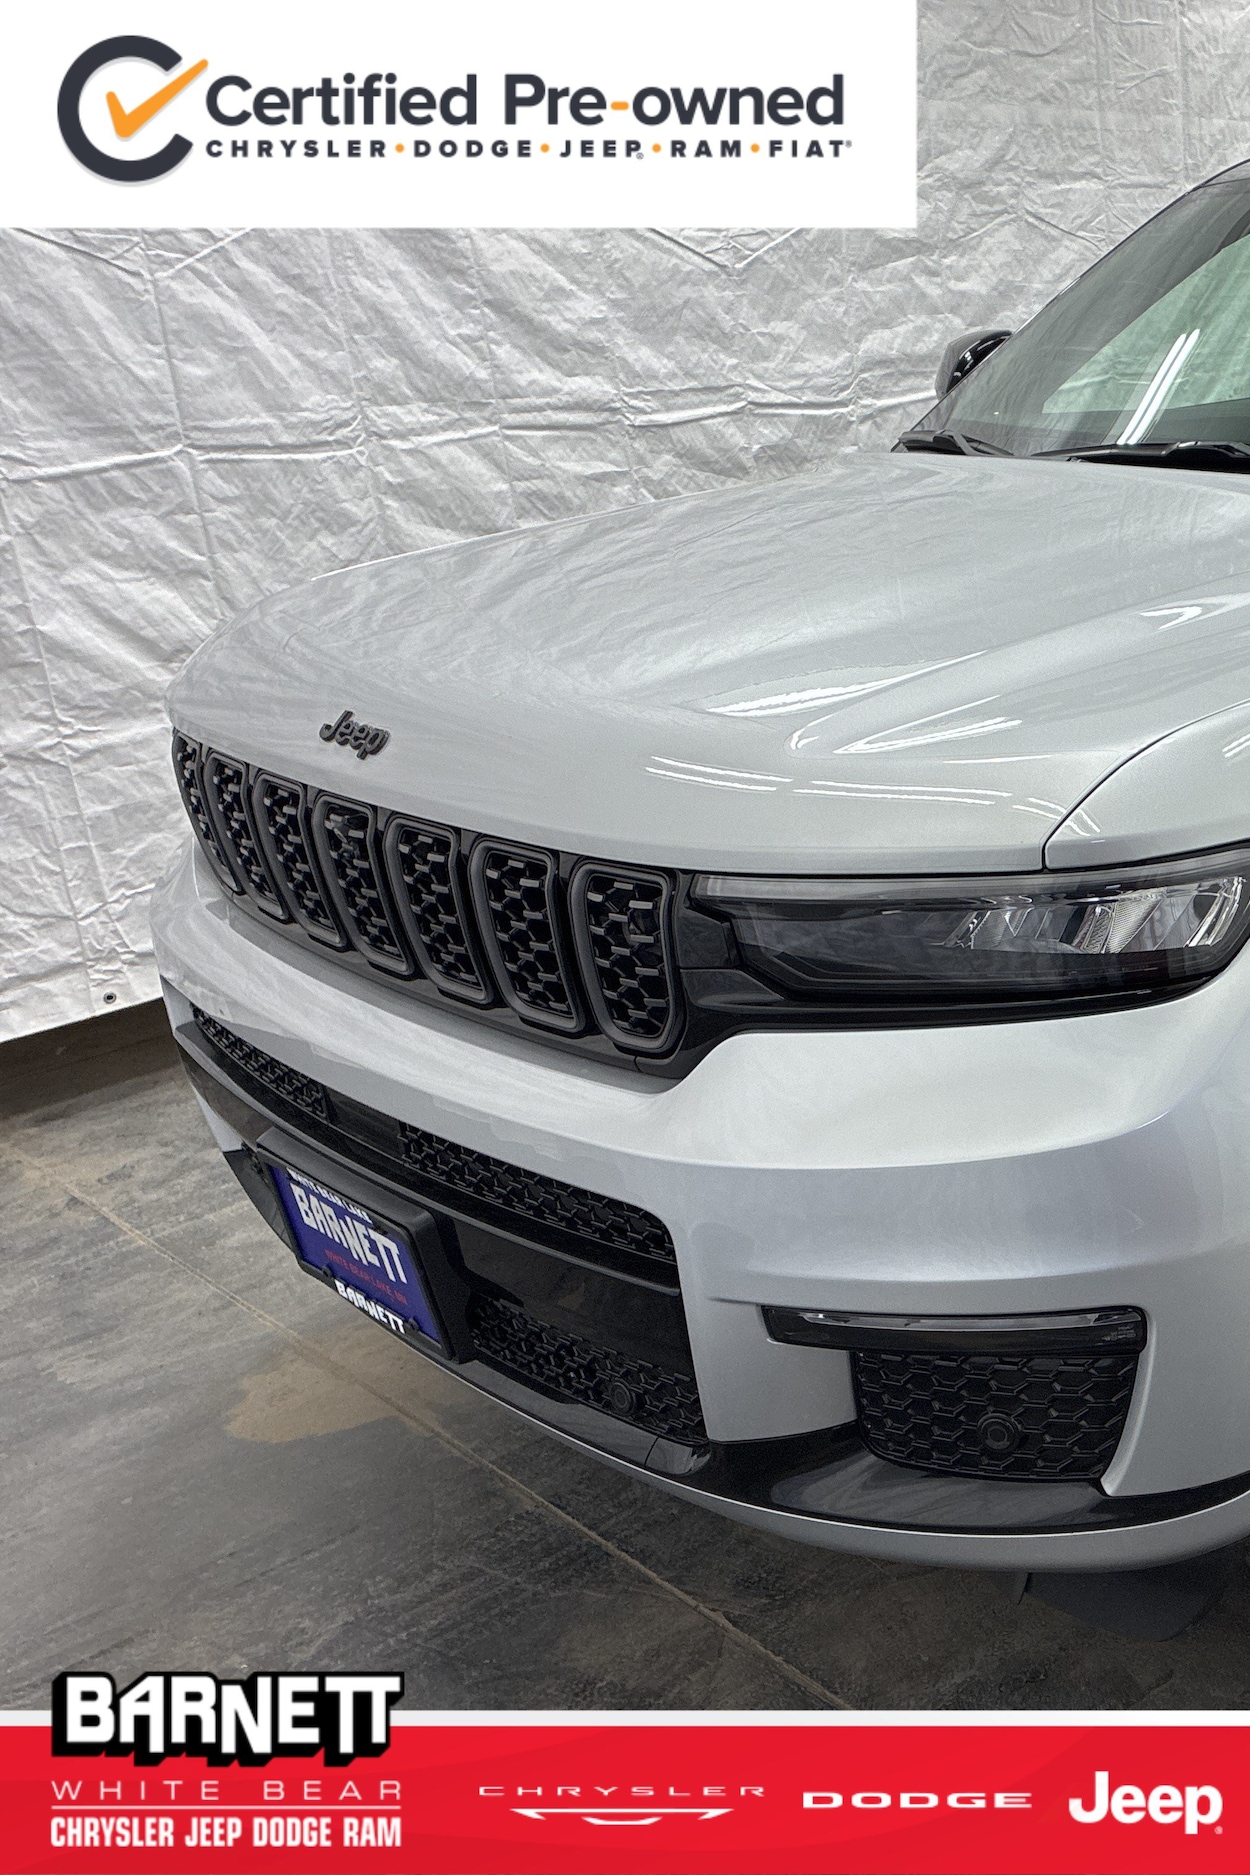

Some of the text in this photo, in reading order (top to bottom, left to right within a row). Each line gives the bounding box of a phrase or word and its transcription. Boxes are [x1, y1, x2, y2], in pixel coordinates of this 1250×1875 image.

[319, 709, 390, 760] Jeep
[289, 1182, 408, 1285] BARNETT
[334, 1278, 406, 1335] BARNETT
